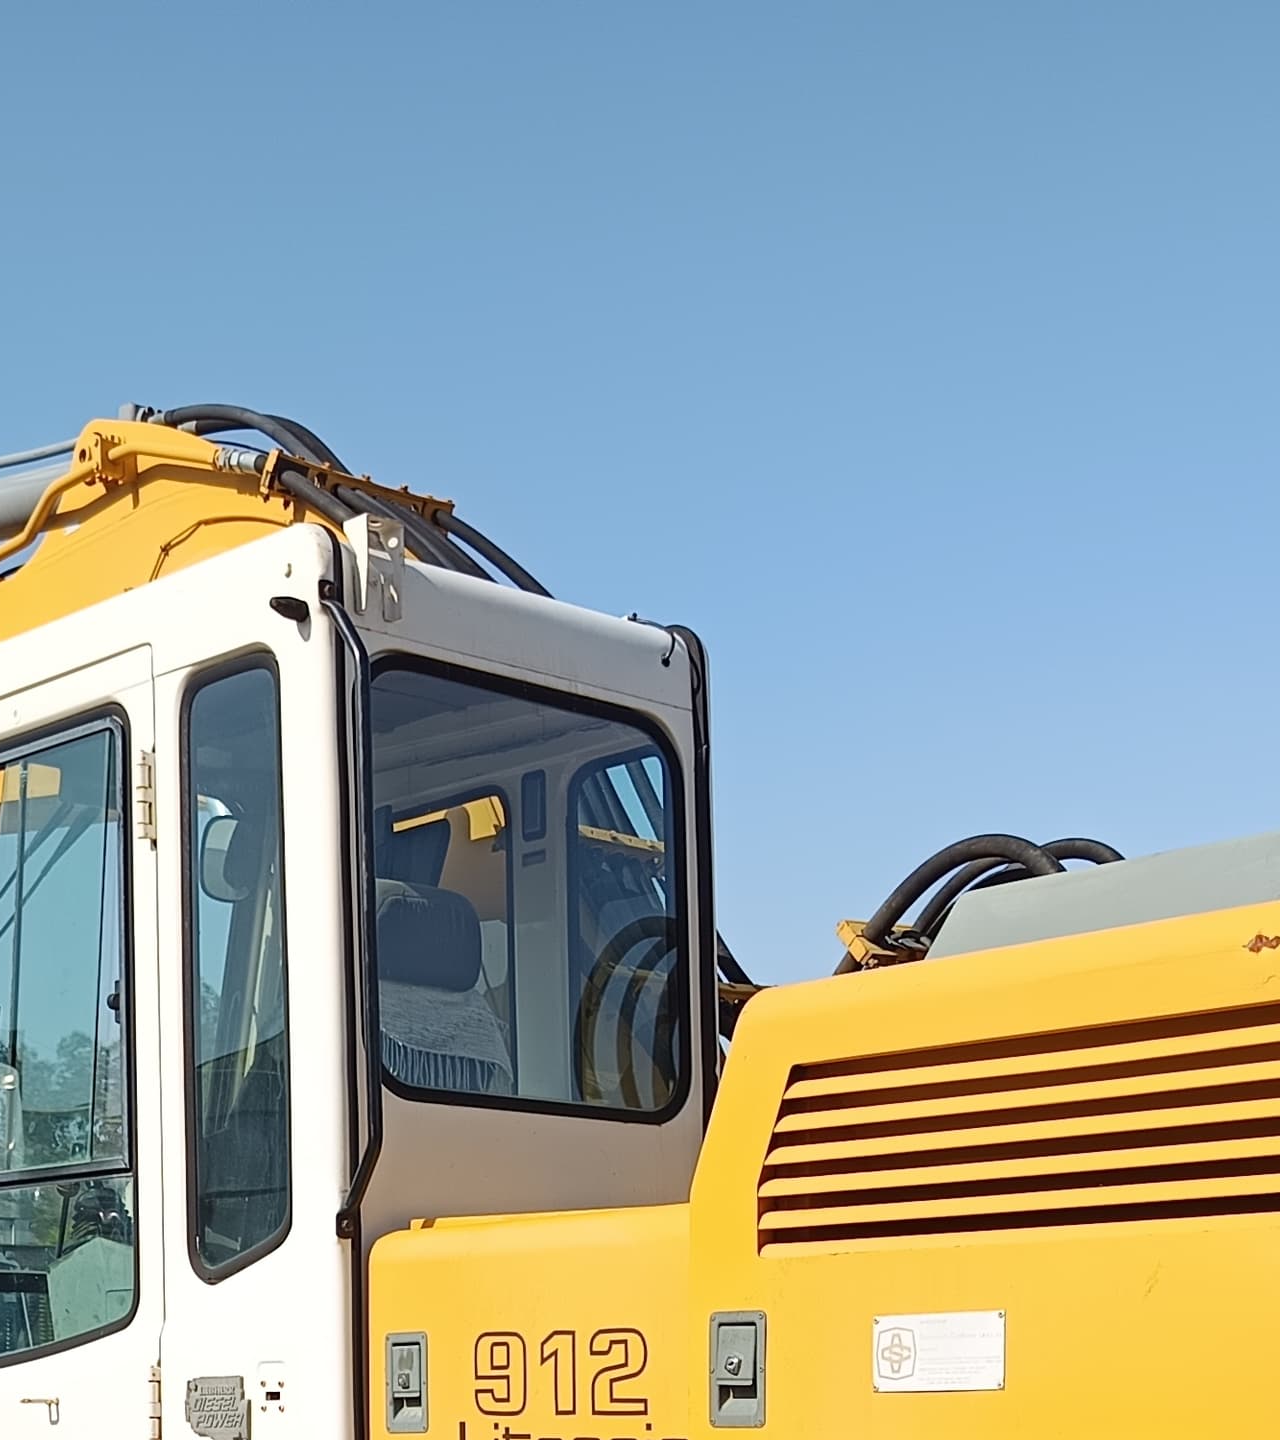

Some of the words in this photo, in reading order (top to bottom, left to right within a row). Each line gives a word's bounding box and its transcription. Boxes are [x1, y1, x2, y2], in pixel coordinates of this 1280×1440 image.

[474, 1328, 648, 1416] 912
[192, 1397, 239, 1412] DIESEL
[197, 1413, 245, 1428] POWER
